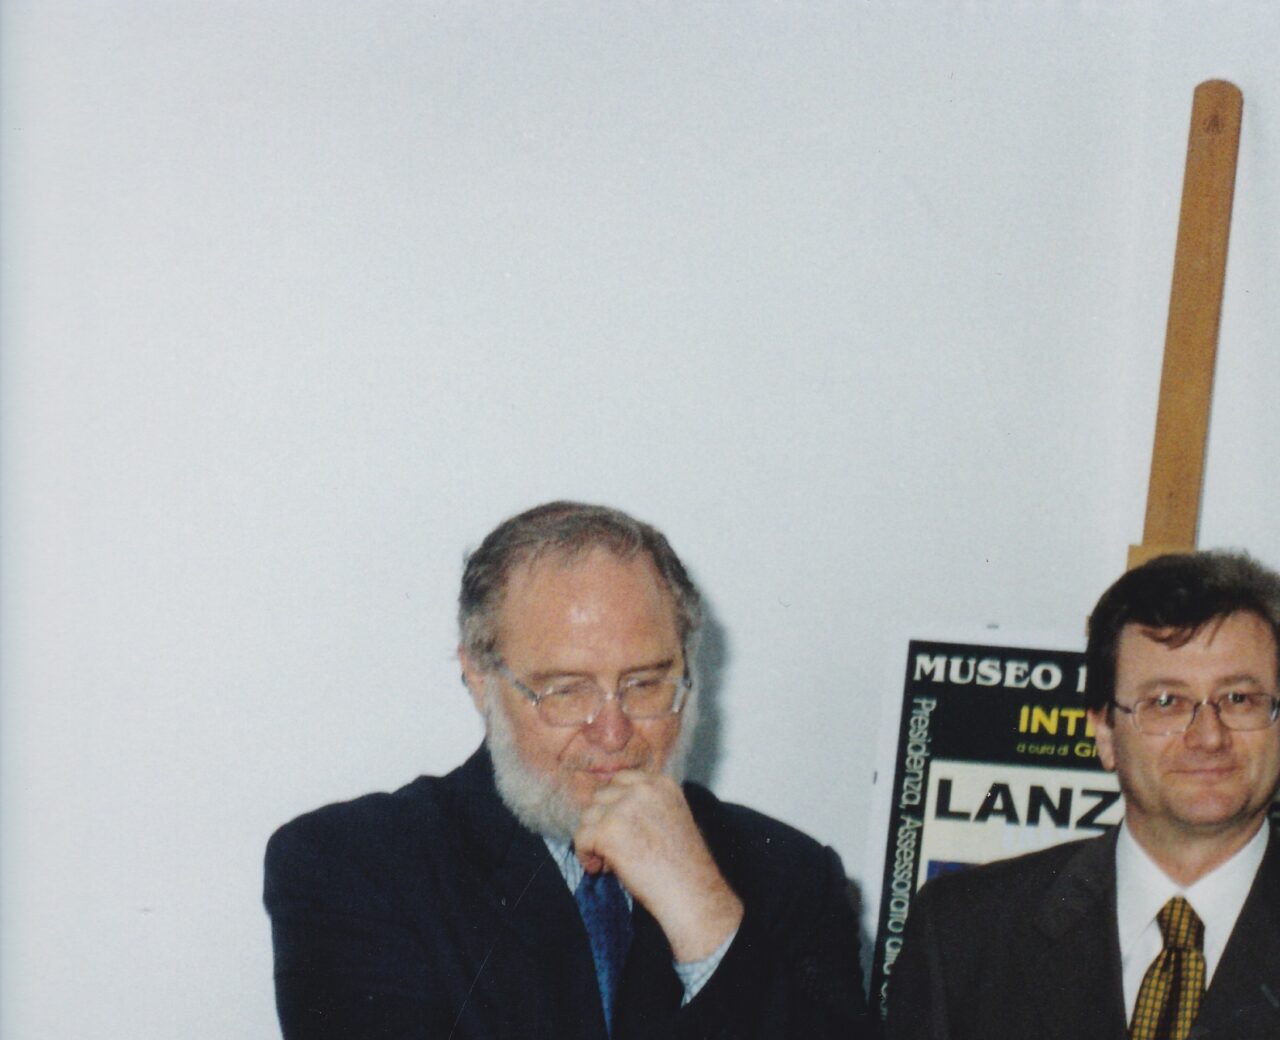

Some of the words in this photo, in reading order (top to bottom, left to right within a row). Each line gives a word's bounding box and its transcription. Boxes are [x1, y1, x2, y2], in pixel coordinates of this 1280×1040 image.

[913, 654, 1063, 691] MUSEO
[900, 697, 937, 808] Presidenza,
[888, 815, 923, 932] Assessorato
